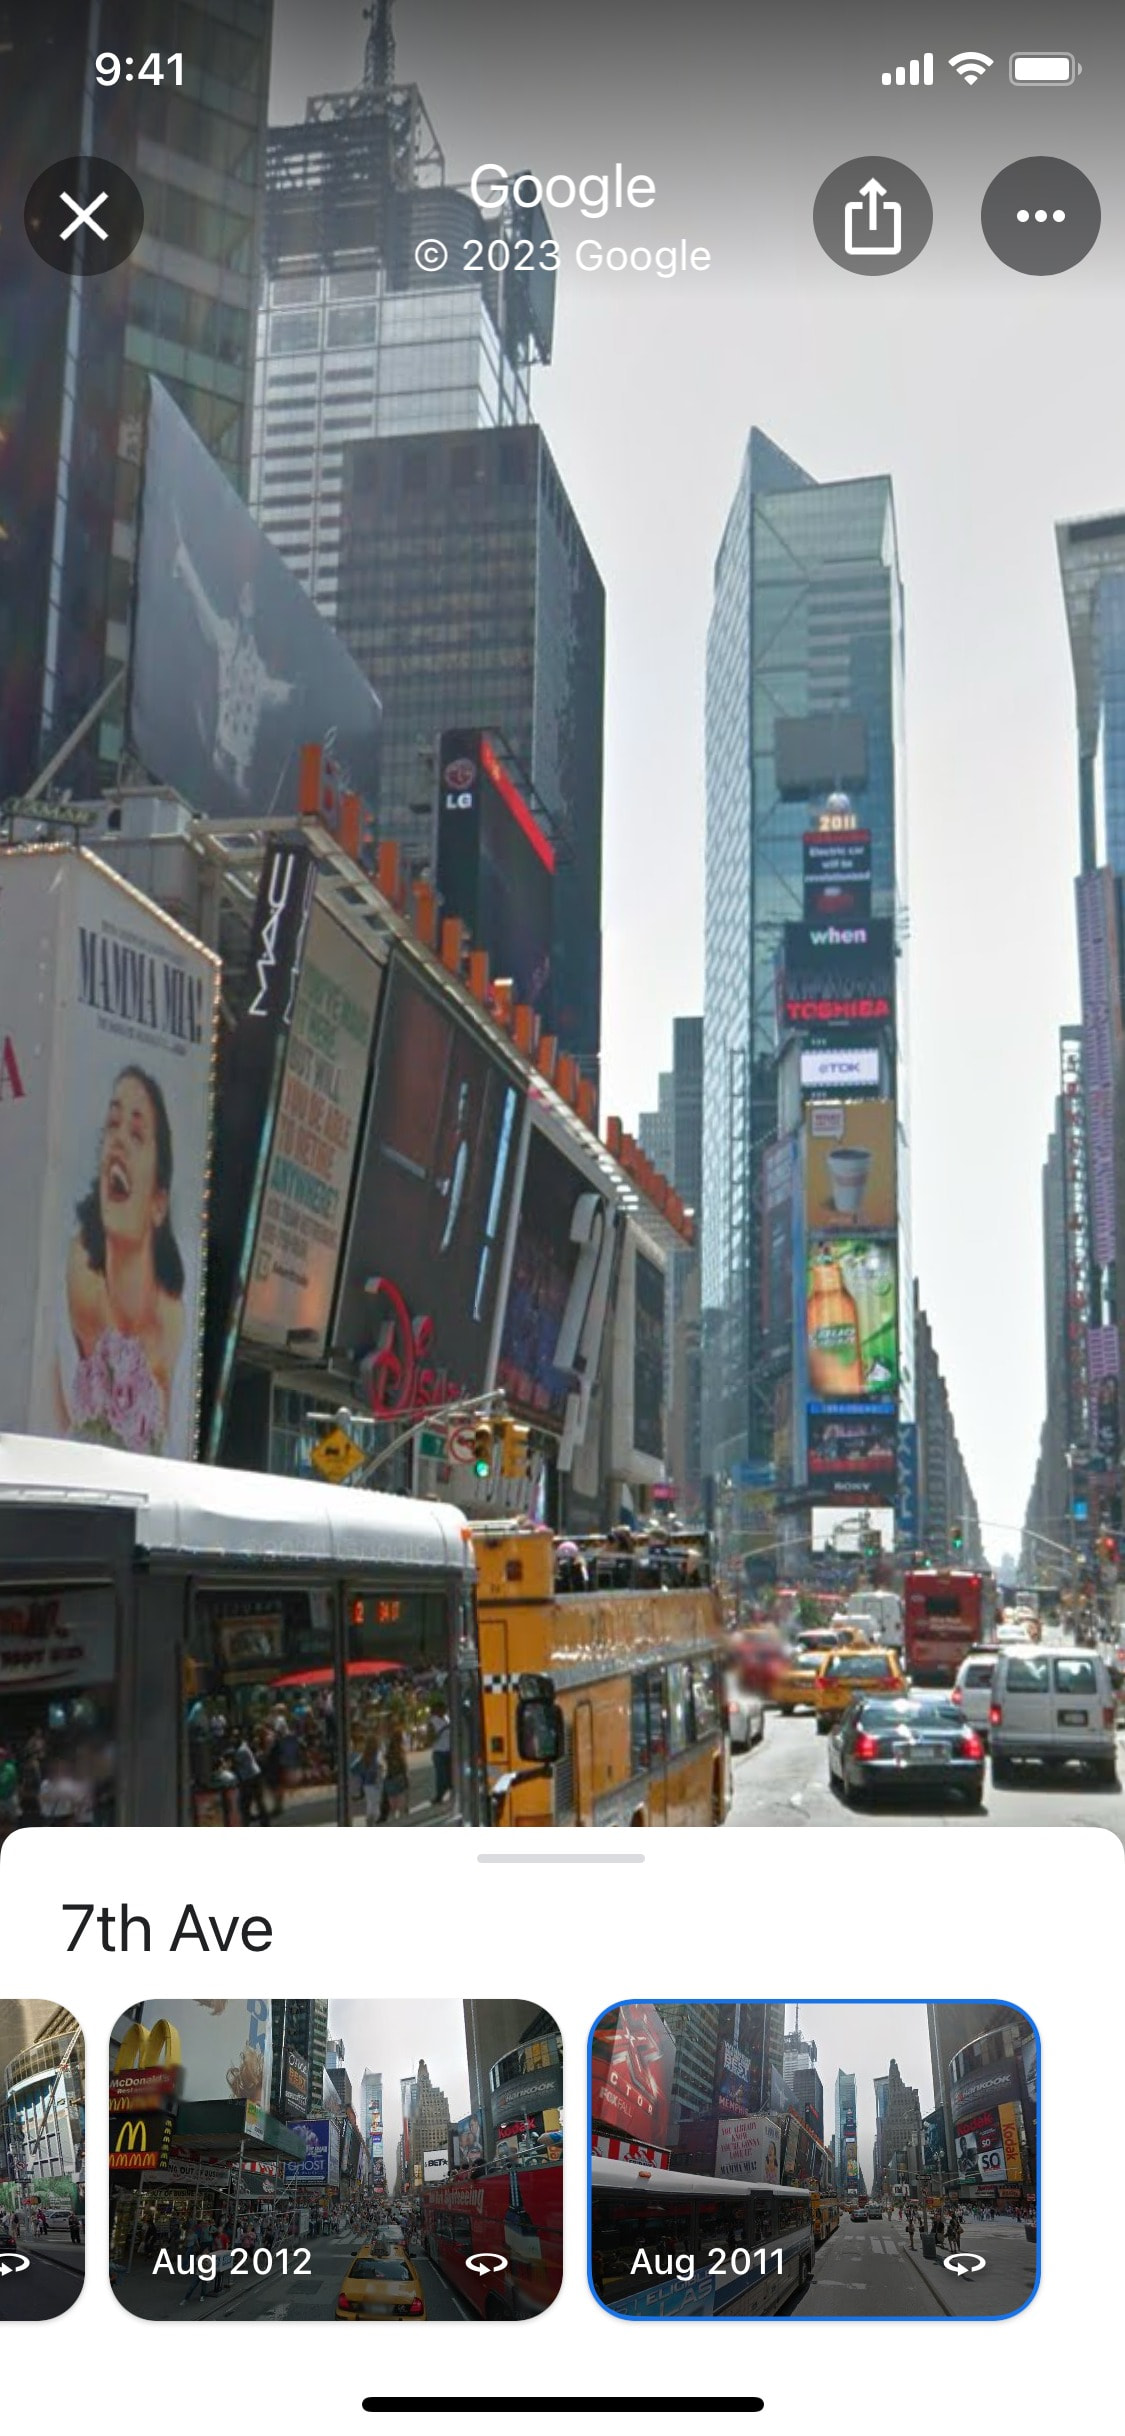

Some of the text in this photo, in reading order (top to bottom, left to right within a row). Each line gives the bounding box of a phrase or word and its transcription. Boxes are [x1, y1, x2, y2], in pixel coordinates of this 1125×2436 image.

[446, 793, 472, 809] LG
[819, 814, 856, 831] 2011
[810, 926, 867, 945] when
[78, 926, 157, 1029] MAMMA
[786, 999, 890, 1021] TOSHIBA
[1003, 2122, 1018, 2161] Kodak
[287, 2160, 325, 2171] GHOST
